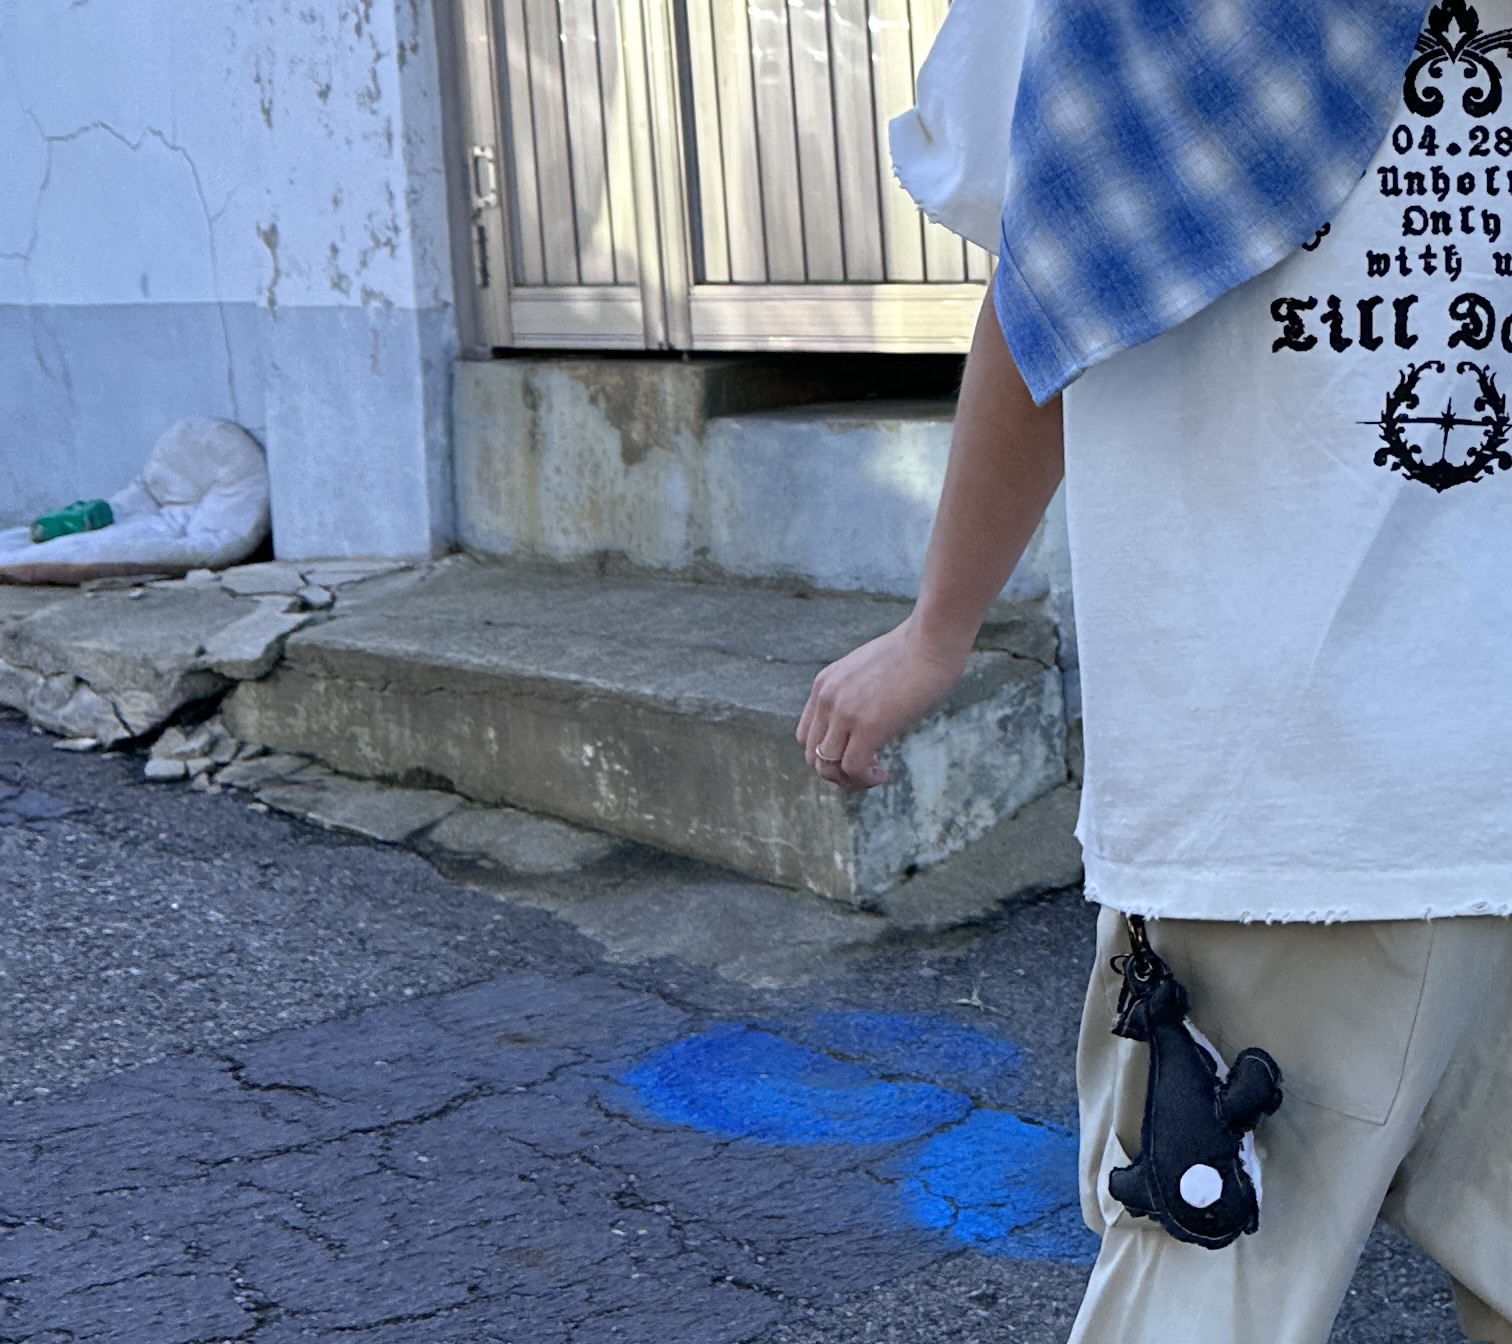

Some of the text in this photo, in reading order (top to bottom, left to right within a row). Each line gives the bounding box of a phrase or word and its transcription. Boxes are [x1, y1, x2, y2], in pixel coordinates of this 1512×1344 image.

[1401, 205, 1501, 243] Only
[1365, 245, 1462, 282] with
[1270, 294, 1419, 353] Till
